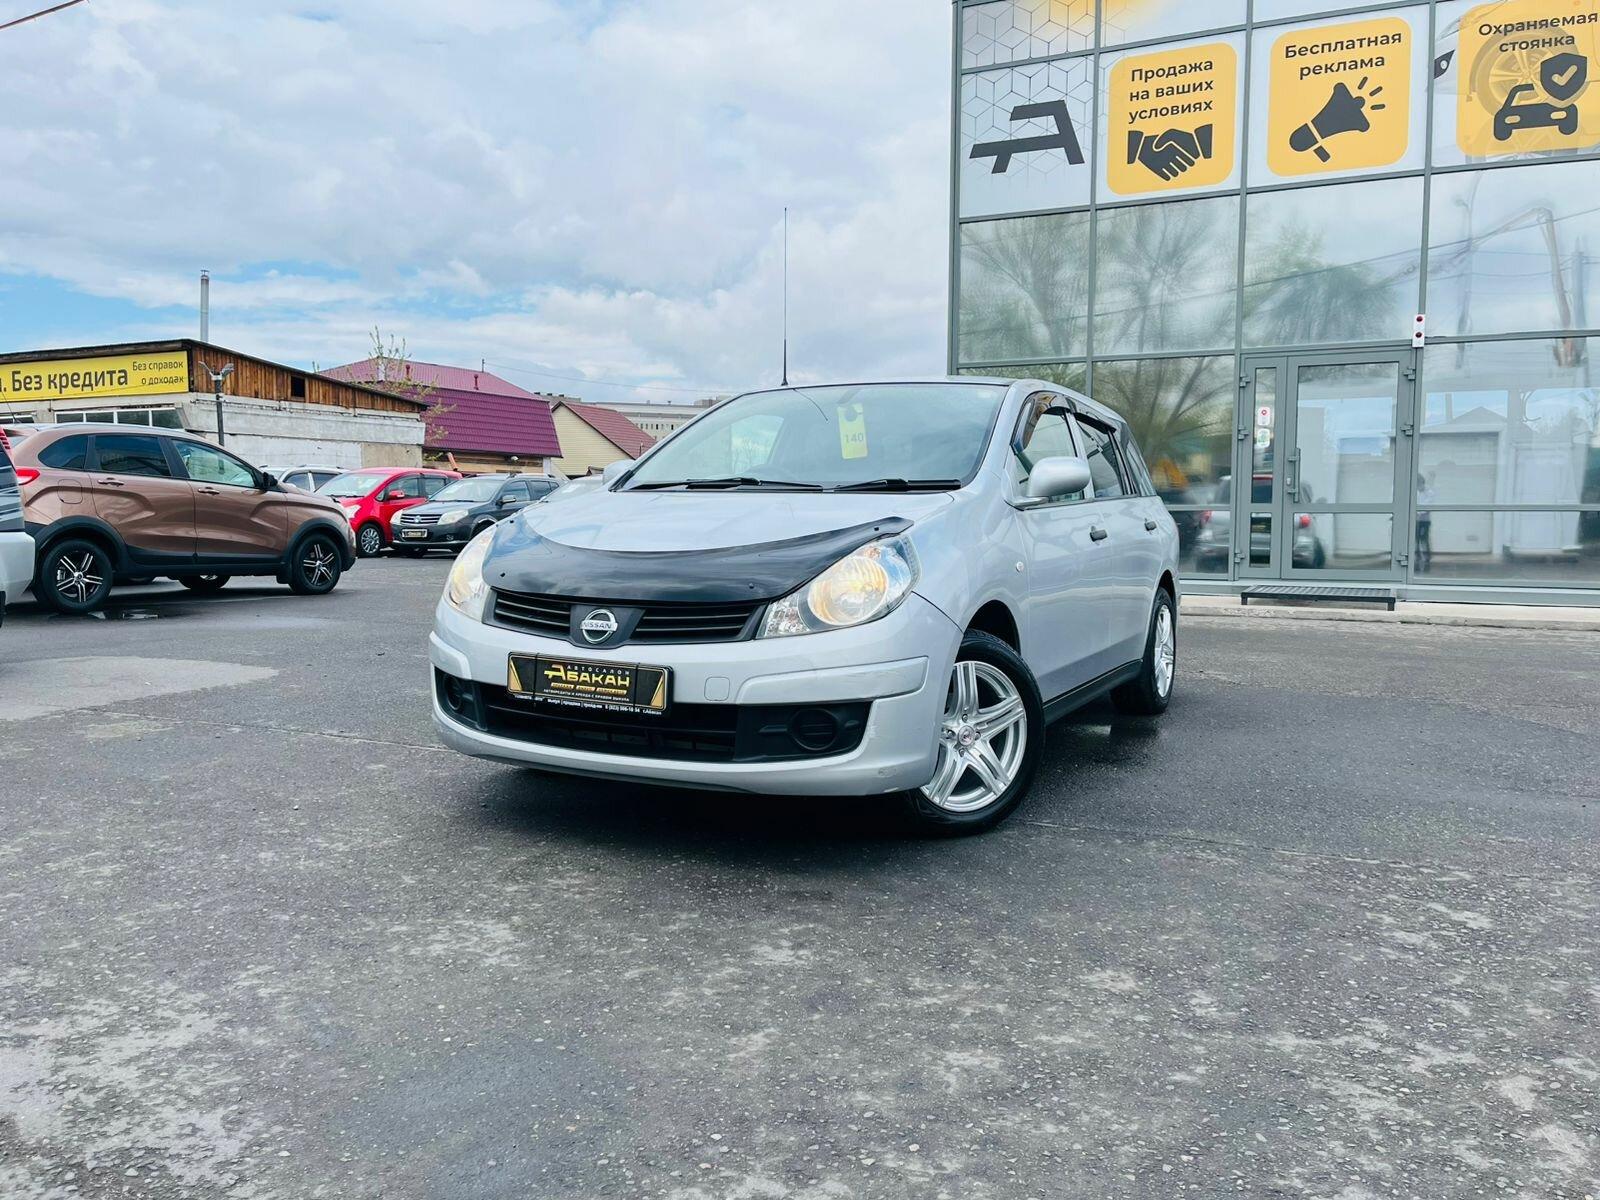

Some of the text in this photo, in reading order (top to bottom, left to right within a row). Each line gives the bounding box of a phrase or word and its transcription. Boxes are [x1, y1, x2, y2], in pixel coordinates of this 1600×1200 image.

[1478, 12, 1598, 36] Охраняемая
[1284, 32, 1402, 59] Бесплатная
[1499, 35, 1575, 53] стоянка
[1130, 57, 1214, 84] Продажа
[1299, 55, 1386, 80] реклама
[1129, 79, 1214, 102] на ваших
[1128, 99, 1213, 124] условиях
[132, 360, 184, 372] Без справок
[11, 370, 43, 392] Без
[48, 368, 128, 394] кредита
[141, 375, 184, 386] о доходах
[845, 432, 864, 443] 140
[582, 621, 612, 629] NISSAN
[567, 664, 630, 675] АВТОСАЛОН
